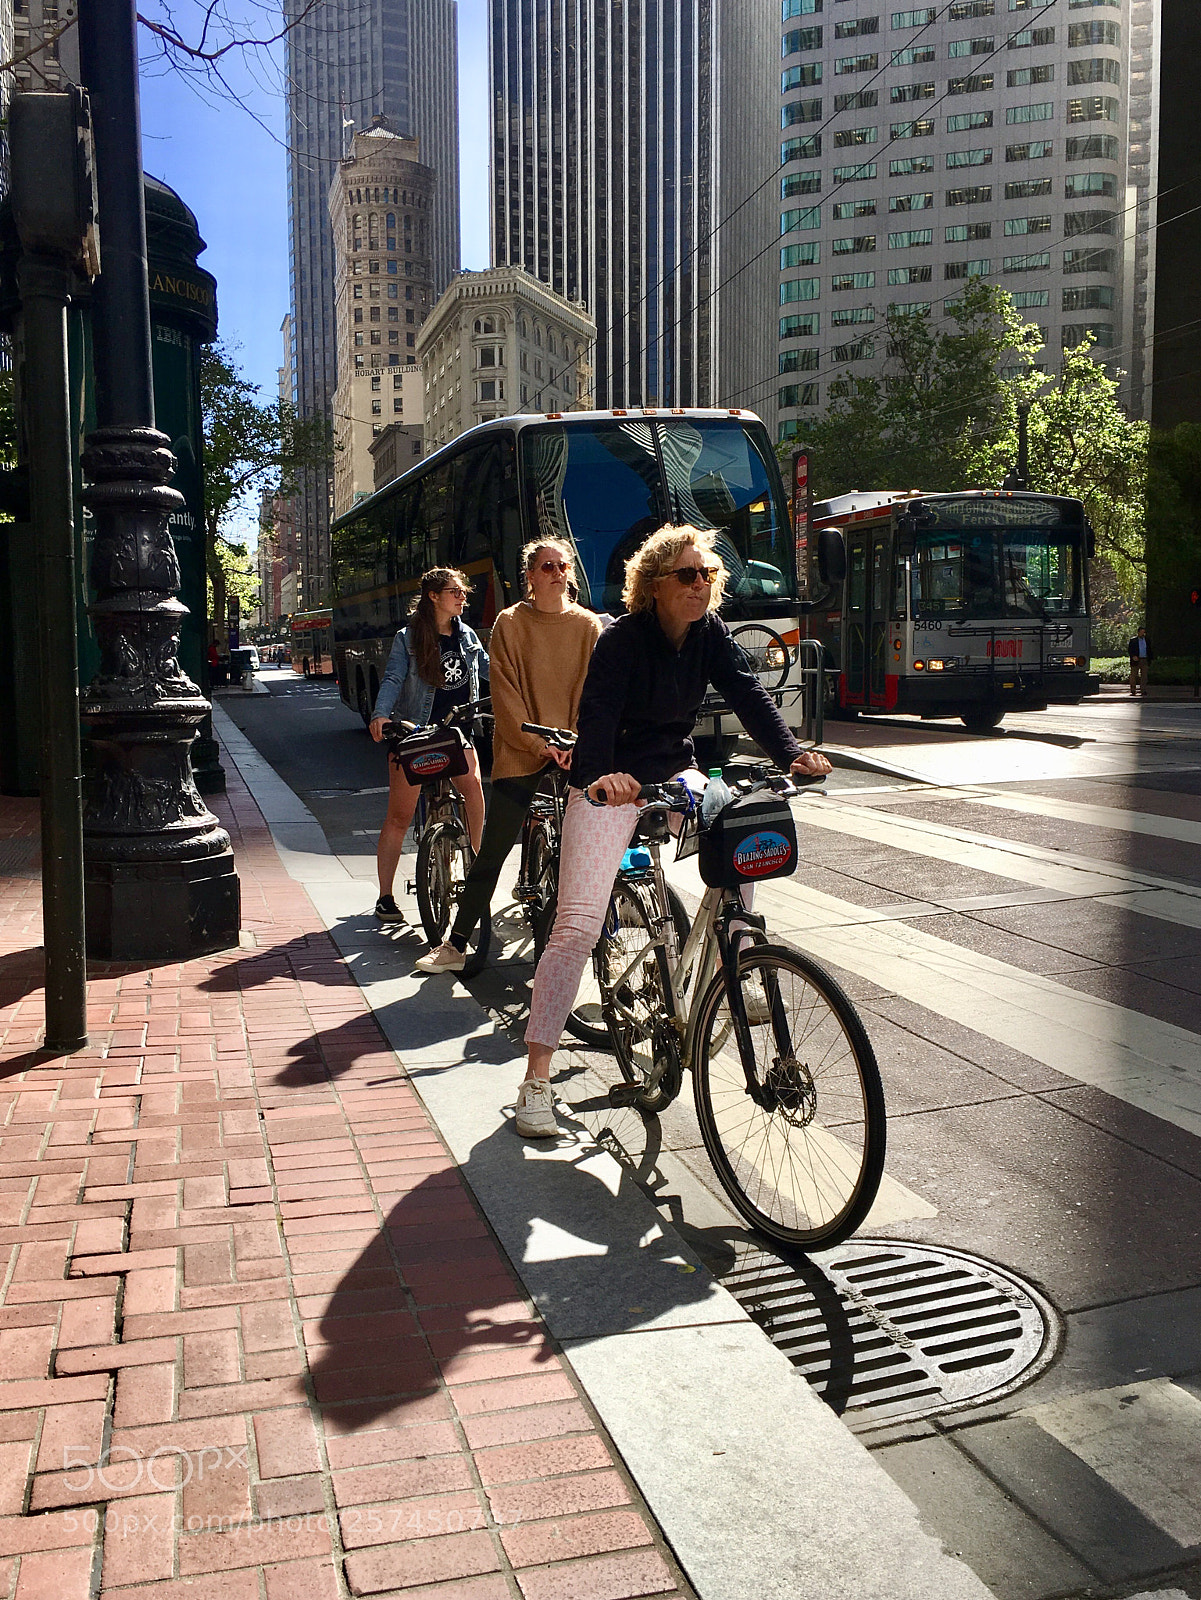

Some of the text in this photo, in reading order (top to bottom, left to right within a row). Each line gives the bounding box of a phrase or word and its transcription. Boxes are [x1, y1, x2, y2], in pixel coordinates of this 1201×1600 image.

[149, 274, 209, 306] ANCISCO
[354, 364, 424, 377] HOBART BUILDING
[168, 511, 197, 531] antly.
[962, 514, 999, 526] Ferry
[914, 621, 942, 630] 5460
[755, 857, 783, 868] FRANCISCO
[859, 1304, 915, 1349] FRANCISCO
